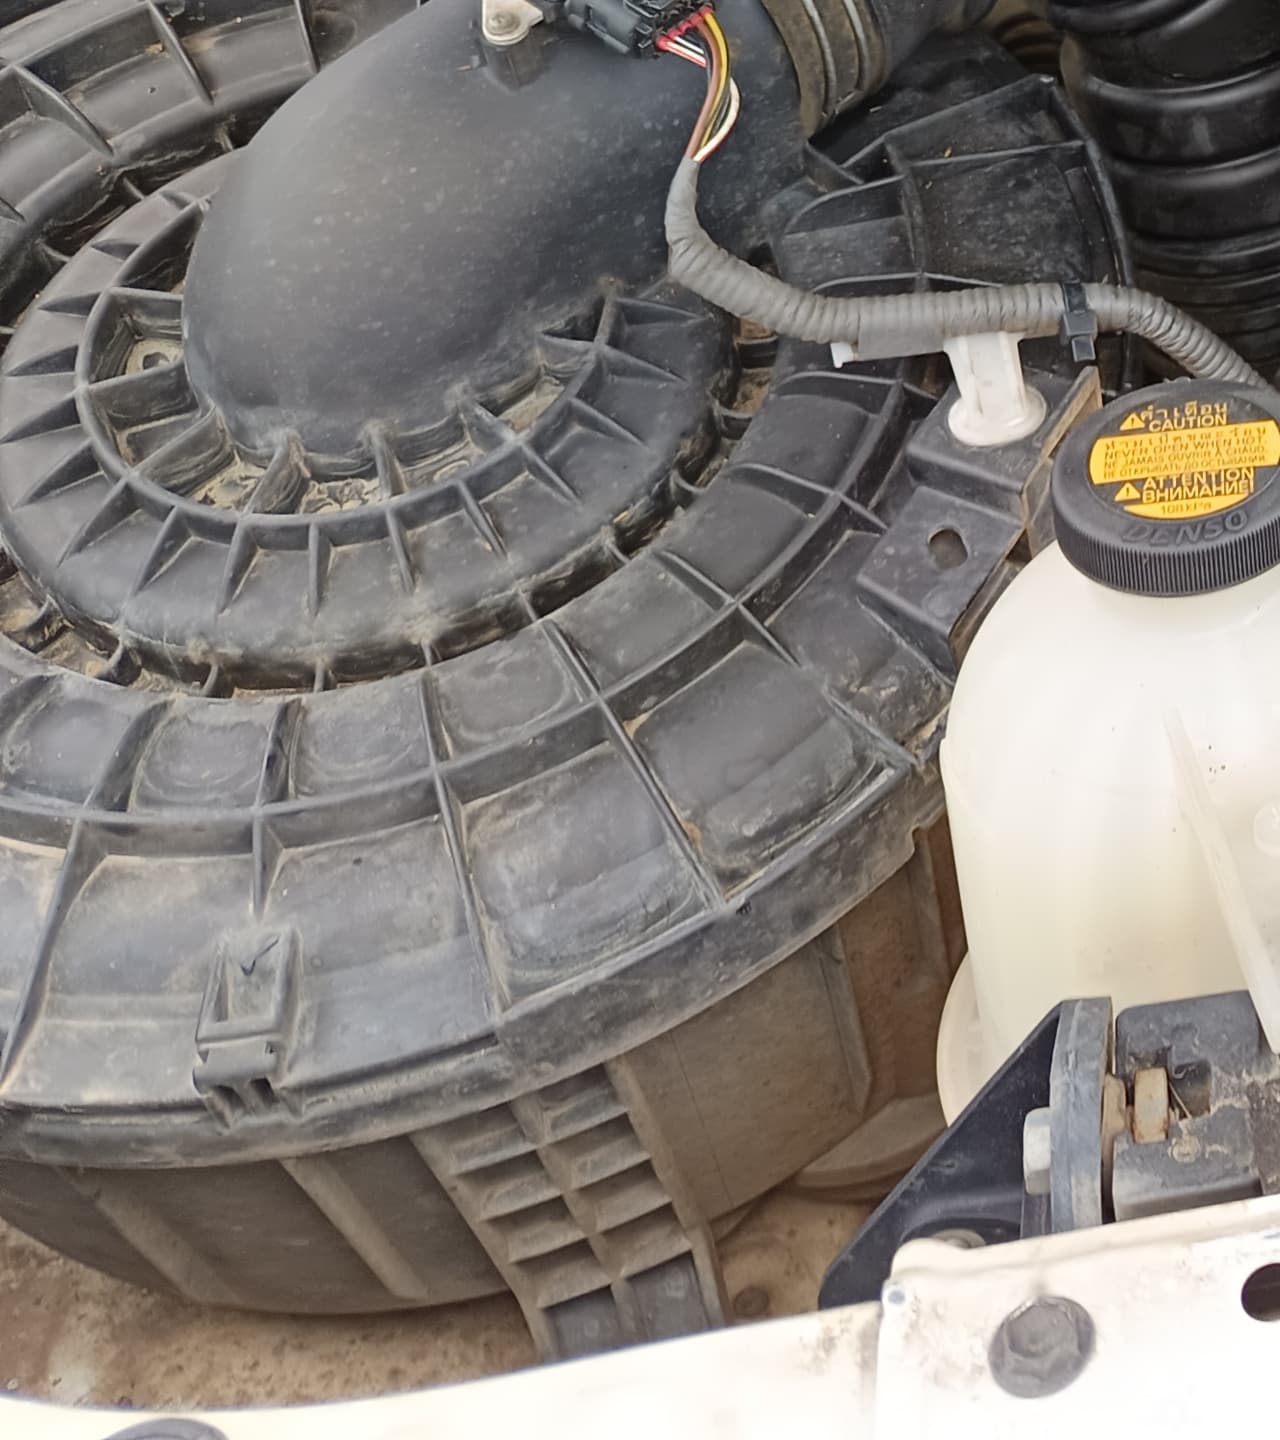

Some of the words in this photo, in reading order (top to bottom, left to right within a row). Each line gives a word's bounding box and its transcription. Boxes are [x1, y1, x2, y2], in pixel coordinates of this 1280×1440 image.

[1148, 414, 1228, 432] CAUTION
[1105, 446, 1151, 460] NEVER
[1153, 442, 1190, 455] OPEN
[1193, 438, 1231, 450] WHEN
[1124, 454, 1165, 466] JAMAIS
[1143, 468, 1255, 491] ATTENTION
[1122, 509, 1249, 546] DENSO
